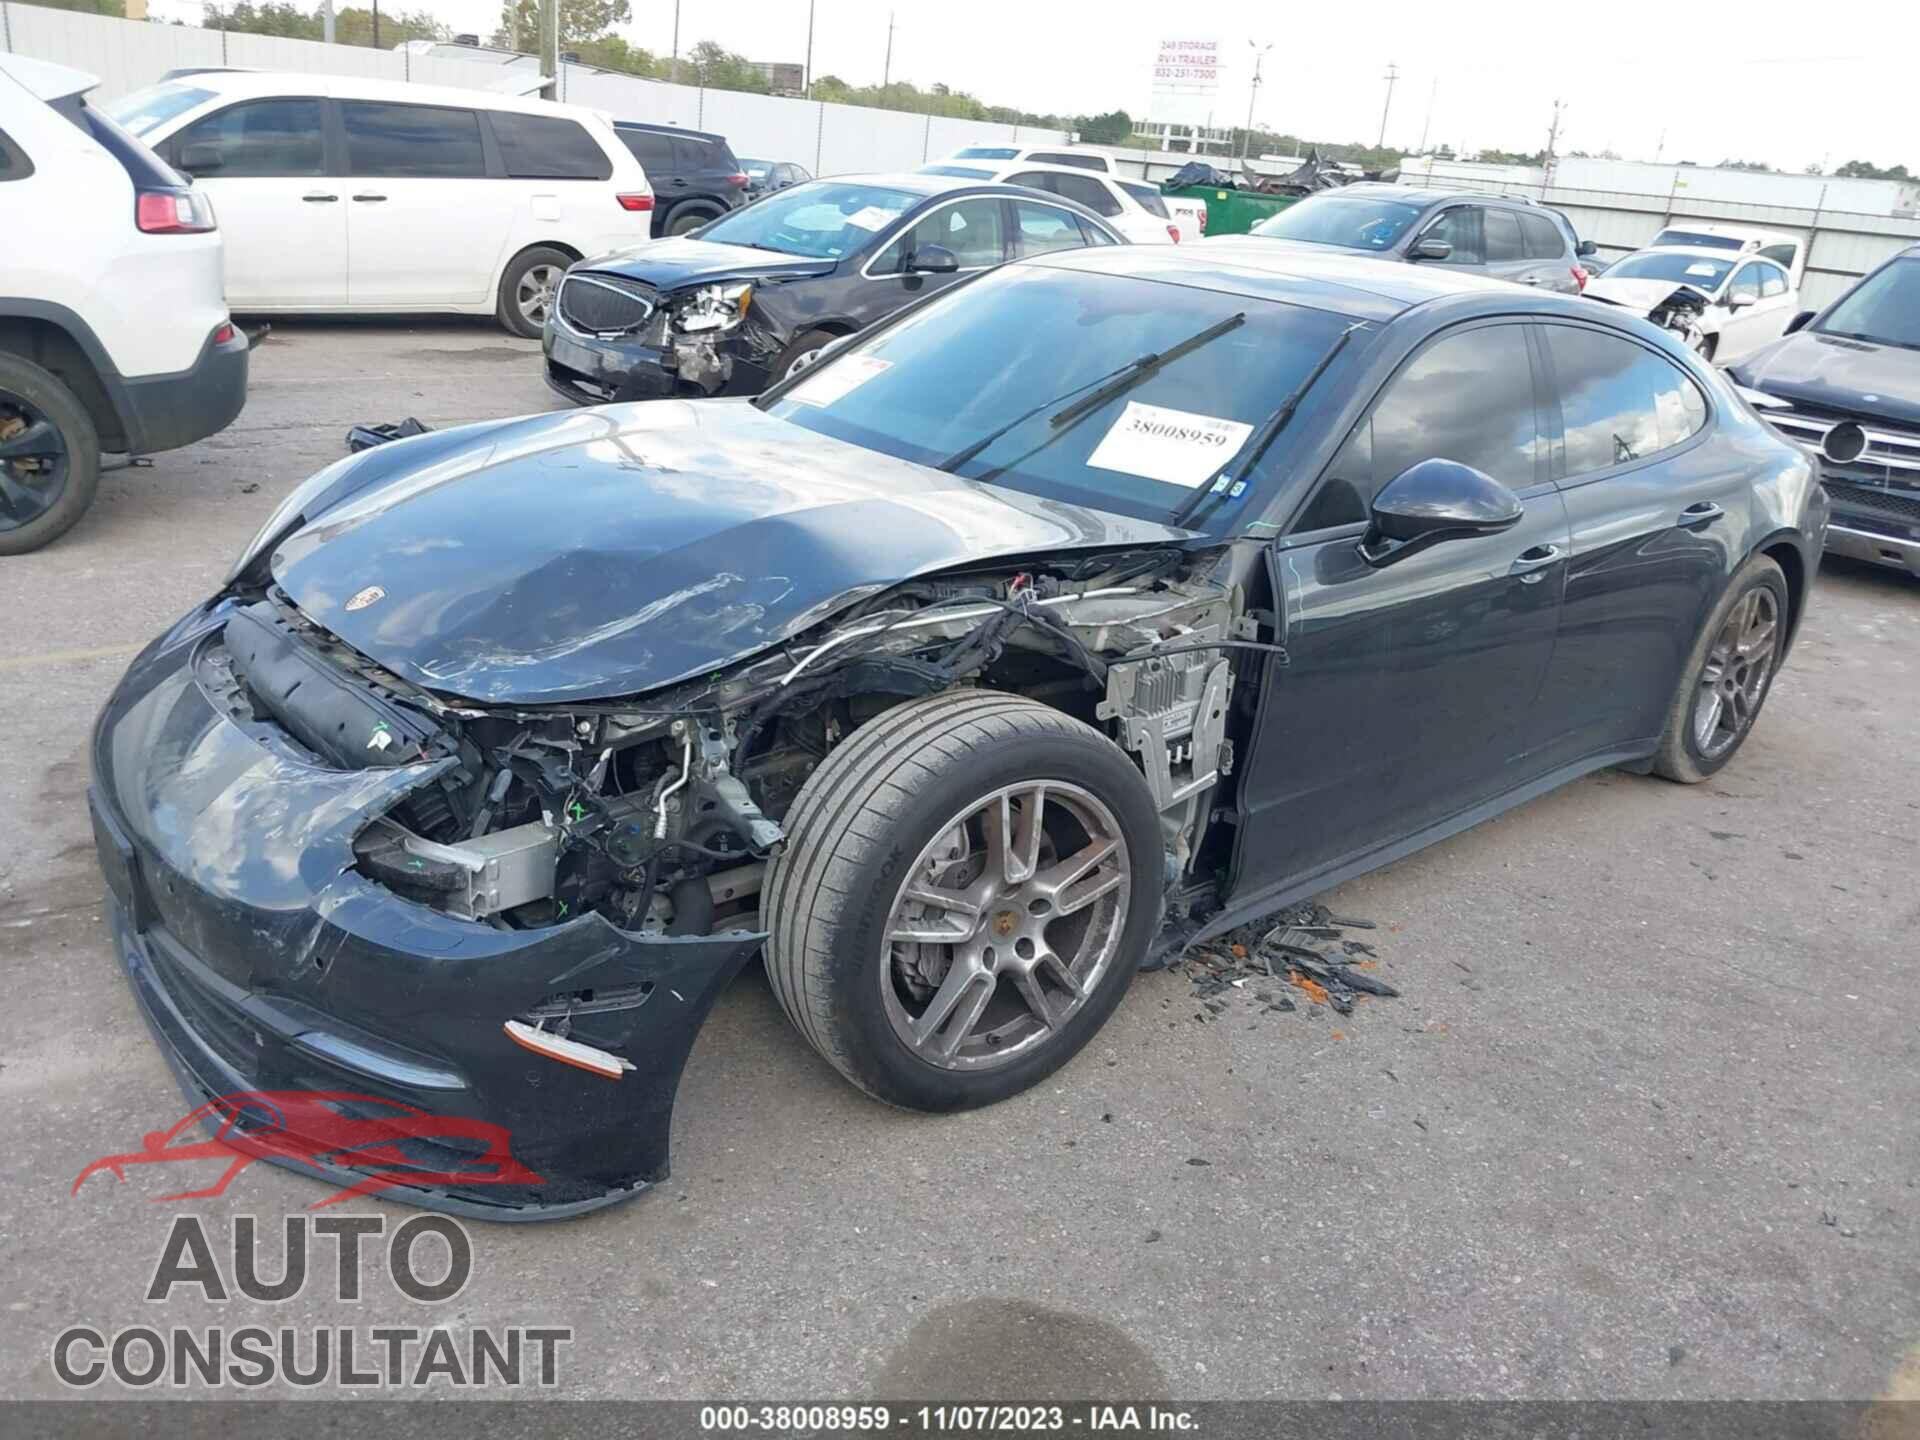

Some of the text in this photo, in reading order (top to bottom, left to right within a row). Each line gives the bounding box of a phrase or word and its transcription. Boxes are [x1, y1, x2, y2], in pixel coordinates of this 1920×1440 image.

[1178, 41, 1217, 51] STORAGE
[1178, 55, 1217, 65] TRAILER
[1126, 418, 1228, 447] 38008959
